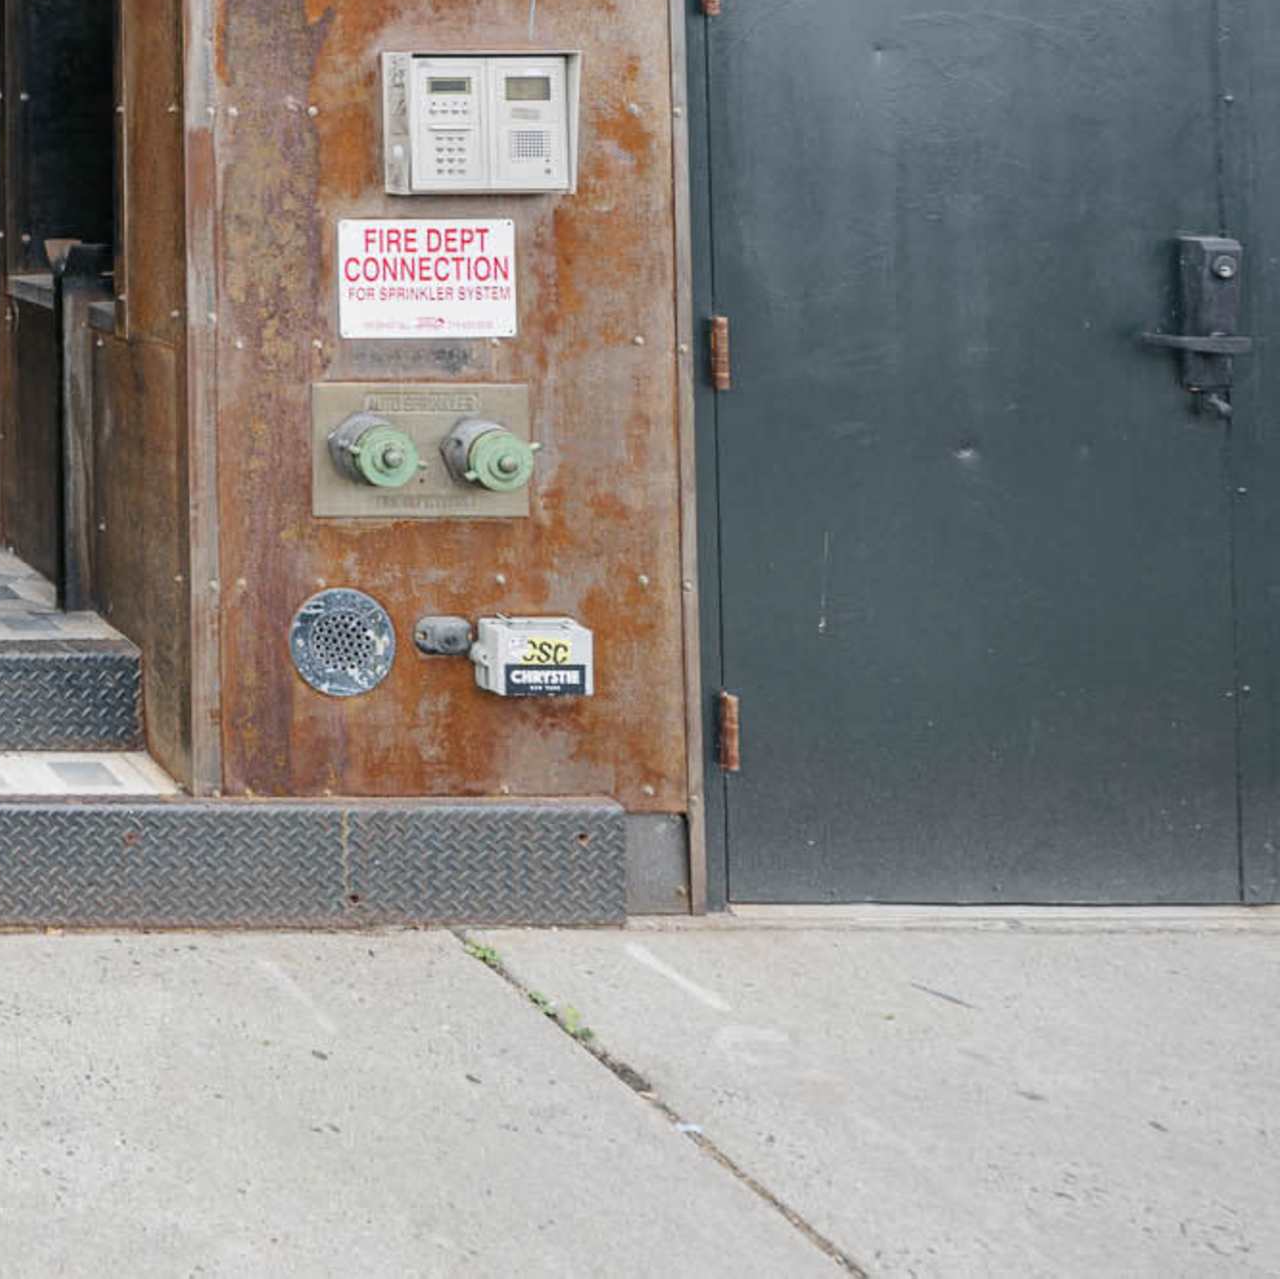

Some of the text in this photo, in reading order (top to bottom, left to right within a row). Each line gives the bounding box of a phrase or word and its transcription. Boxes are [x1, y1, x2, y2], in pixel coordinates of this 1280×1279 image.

[364, 228, 489, 253] FIRE DEPT
[343, 256, 509, 282] CONNECTION
[348, 286, 511, 301] FOR SPRINKLER SYSTEM
